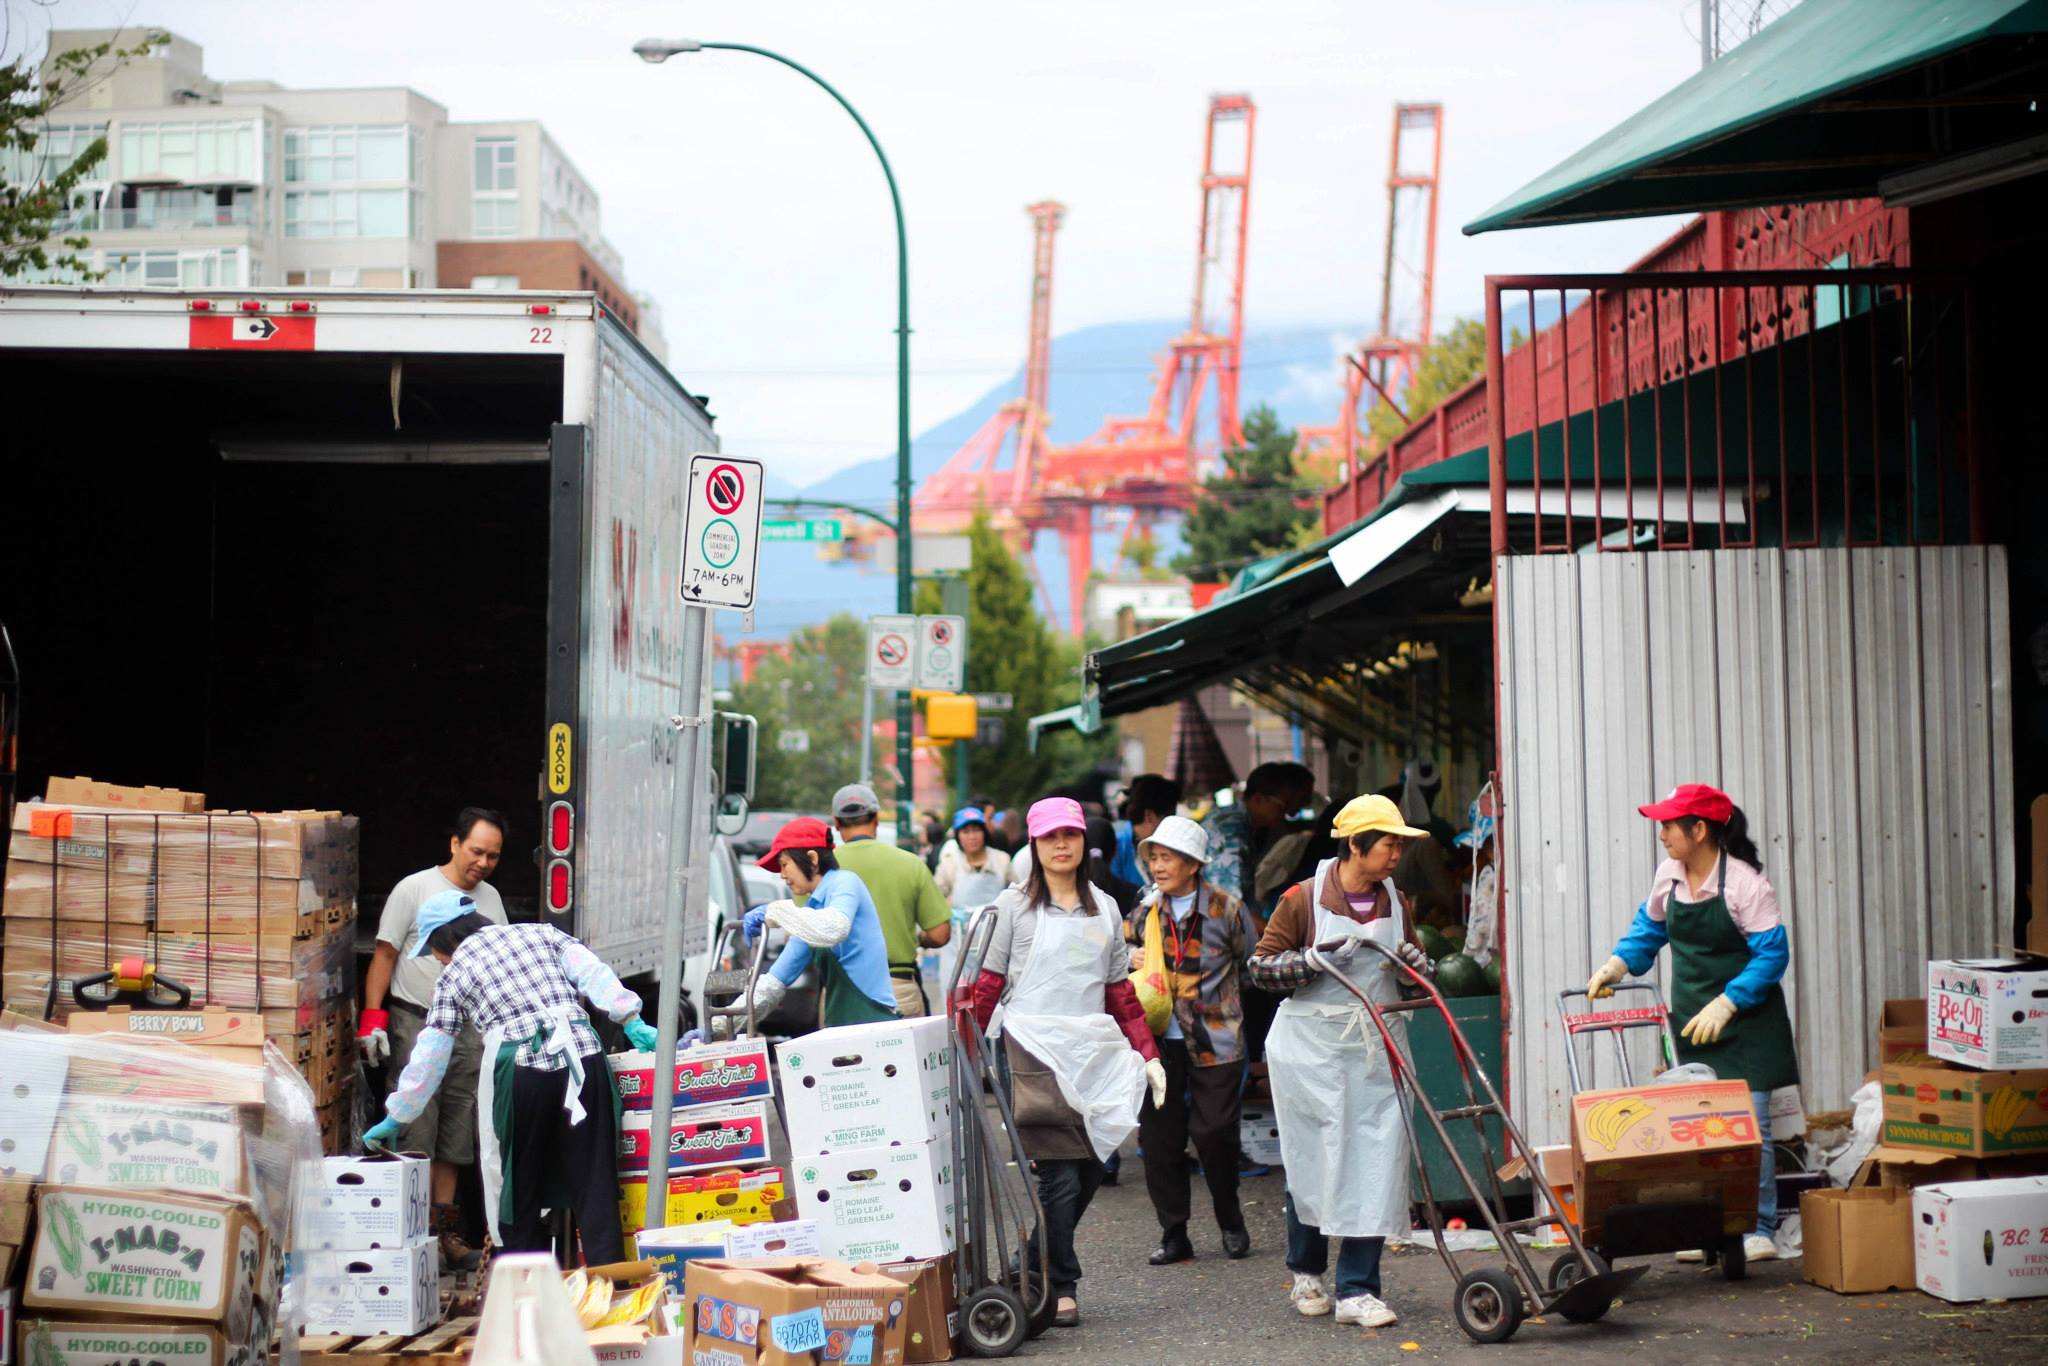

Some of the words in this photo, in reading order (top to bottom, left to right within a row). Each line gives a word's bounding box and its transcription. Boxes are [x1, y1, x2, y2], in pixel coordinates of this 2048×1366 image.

[530, 327, 553, 344] 22
[705, 531, 737, 542] COMMERCIAL
[709, 541, 731, 551] LOADING
[713, 551, 726, 560] ZONE
[554, 731, 565, 786] MAXON
[128, 1014, 169, 1032] BERRY
[171, 1015, 205, 1033] BOWL
[881, 1038, 903, 1047] DOZEN
[678, 1069, 718, 1091] Sweet
[719, 1062, 758, 1088] Treat
[830, 1082, 865, 1093] ROMAINE
[832, 1093, 849, 1102] RED
[850, 1091, 869, 1100] LEAF
[833, 1101, 860, 1111] GREEN
[861, 1098, 881, 1106] LEAF
[824, 1133, 834, 1143] K.
[835, 1130, 859, 1142] MING
[860, 1127, 886, 1138] FARM
[1670, 1115, 1756, 1147] Dole
[670, 1131, 712, 1153] Sweet
[712, 1126, 753, 1150] Treat
[130, 1154, 199, 1167] WASHINGTON
[897, 1153, 918, 1162] DOZEN
[107, 1161, 169, 1183] SWEET
[174, 1167, 220, 1186] CORN
[845, 1196, 881, 1207] ROMAINE
[82, 1201, 221, 1230] HYDRO-COOLED
[847, 1207, 862, 1216] RED
[863, 1205, 883, 1214] LEAF
[847, 1215, 875, 1225] GREEN
[875, 1213, 895, 1221] LEAF
[838, 1248, 847, 1257] K.
[849, 1245, 873, 1257] MING
[874, 1242, 900, 1253] FARM
[110, 1263, 182, 1278] WASHINGTON
[85, 1271, 148, 1297] SWEET
[153, 1277, 203, 1301] CORN
[825, 1299, 875, 1308] CALIFORNIA
[822, 1307, 884, 1321] ANTALOUPES
[775, 1318, 820, 1342] 567079
[67, 1338, 208, 1355] HYDRO-COOLED
[620, 1350, 644, 1361] LTD.
